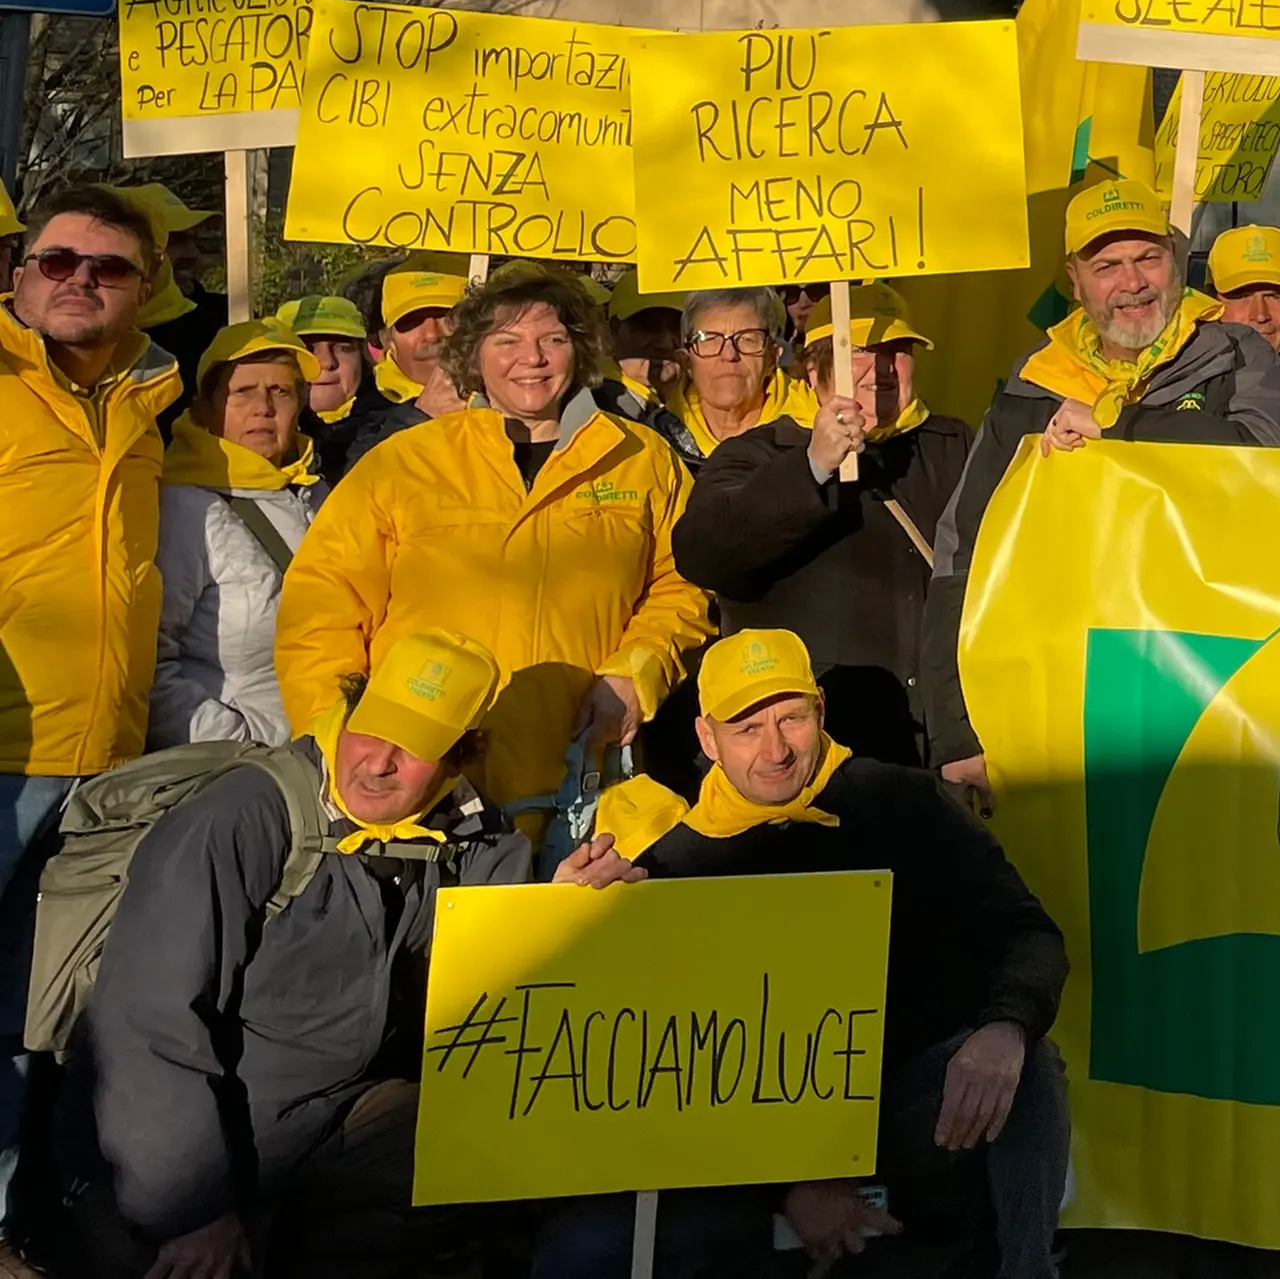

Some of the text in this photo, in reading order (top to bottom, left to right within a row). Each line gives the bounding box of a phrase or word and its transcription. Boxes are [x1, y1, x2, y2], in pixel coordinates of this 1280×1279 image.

[128, 5, 314, 71] e PESCATOR
[330, 5, 631, 92] STOP importazi
[199, 72, 238, 110] LA
[246, 60, 306, 111] PA
[317, 73, 634, 148] CIBI extracomunit
[691, 89, 909, 163] RICERCA
[398, 139, 550, 202] SENZA
[730, 174, 863, 225] MENO
[343, 186, 637, 258] CONTROLLO
[1086, 201, 1145, 221] COLDIRETTI
